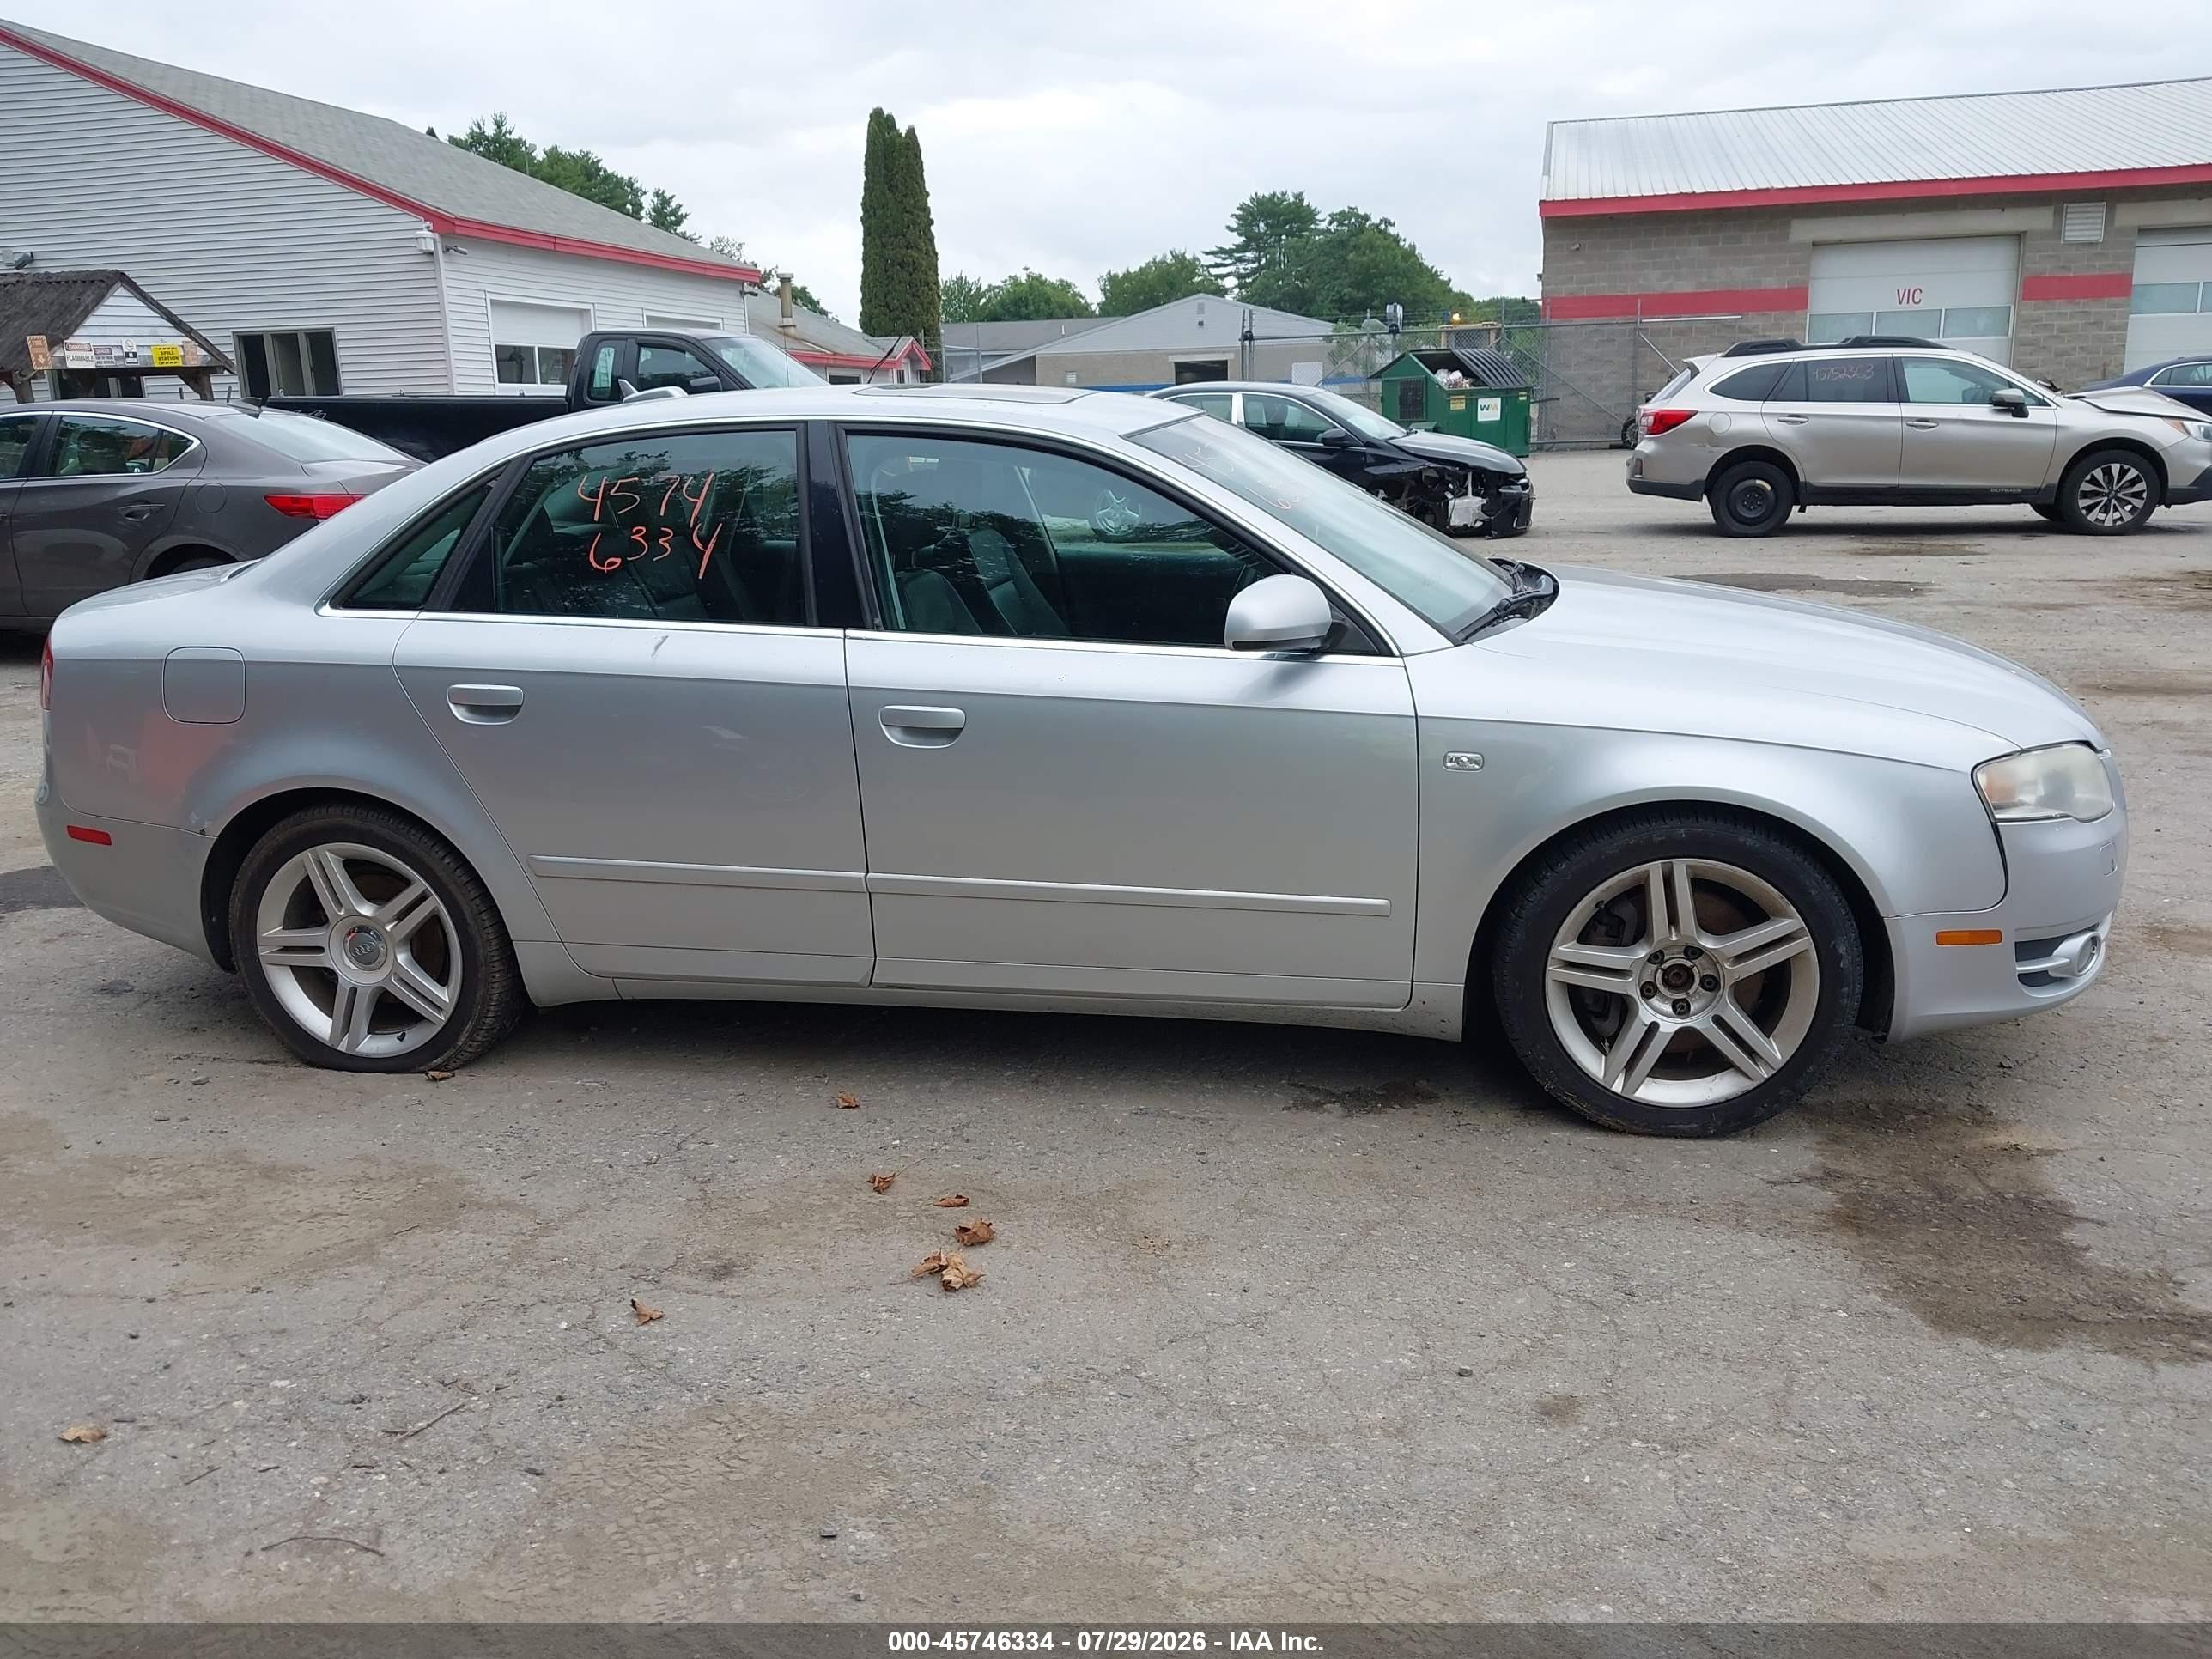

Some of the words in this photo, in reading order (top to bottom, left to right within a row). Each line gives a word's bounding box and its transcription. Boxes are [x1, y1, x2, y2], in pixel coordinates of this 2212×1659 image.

[1897, 288, 1923, 305] VIC
[577, 472, 715, 529] 4574
[588, 523, 723, 580] 6334
